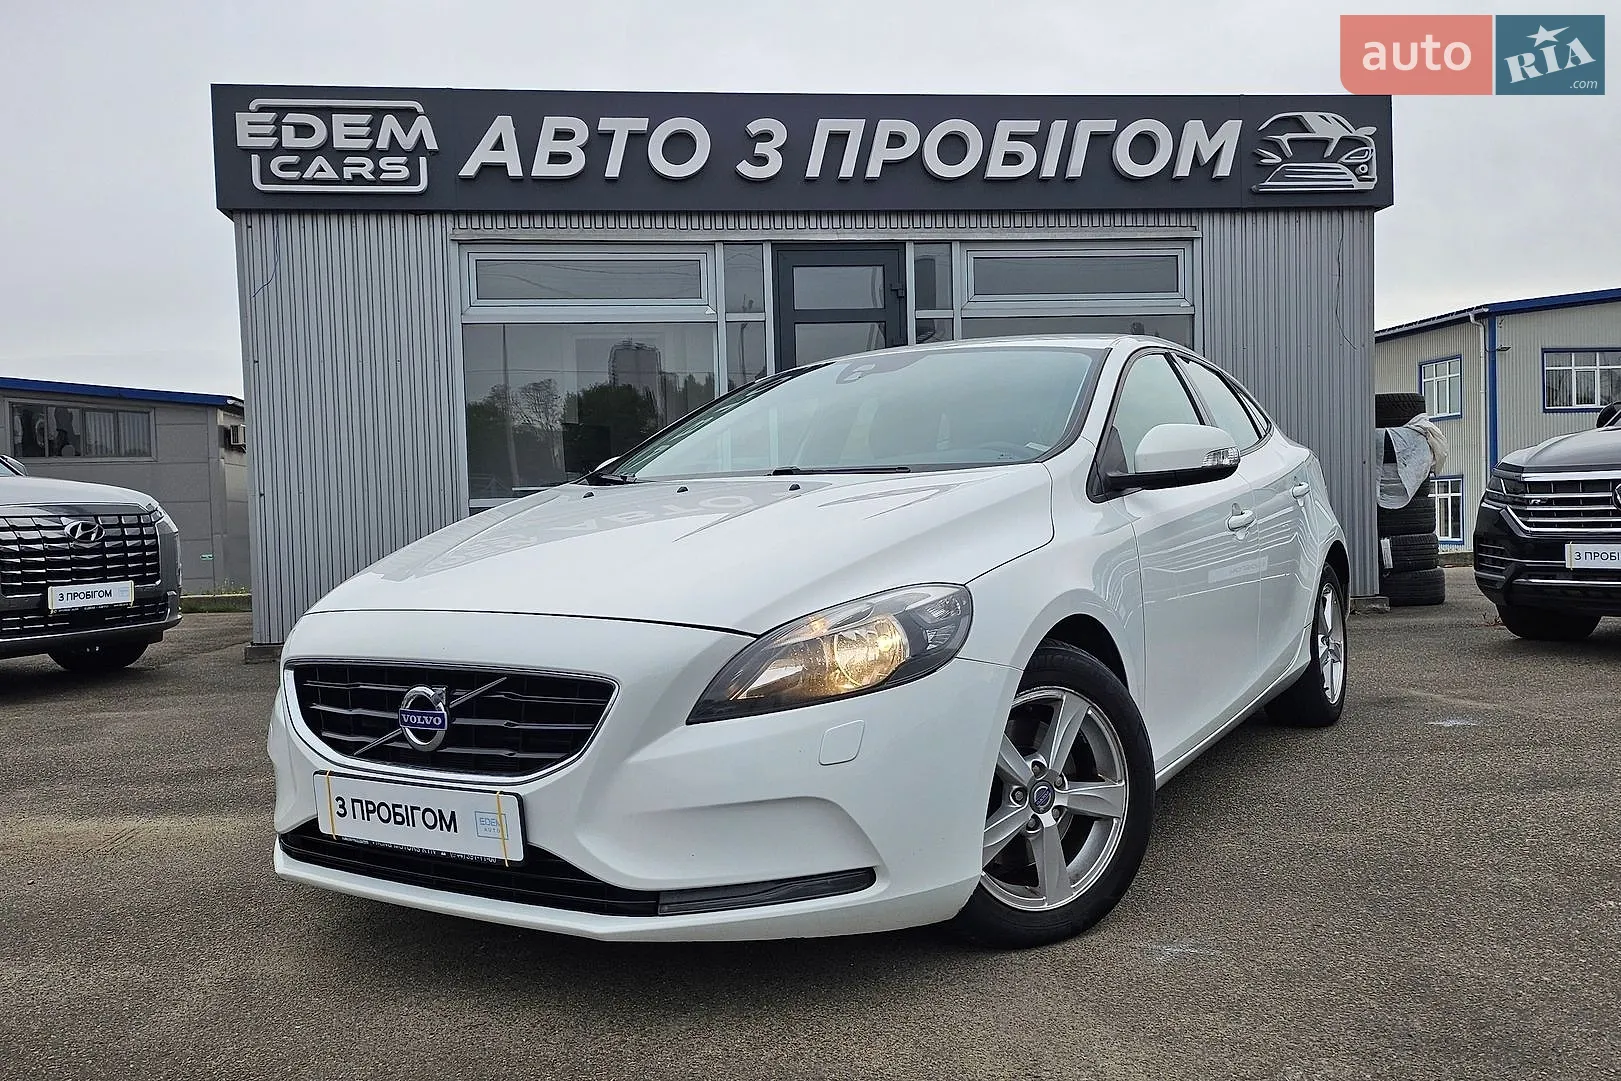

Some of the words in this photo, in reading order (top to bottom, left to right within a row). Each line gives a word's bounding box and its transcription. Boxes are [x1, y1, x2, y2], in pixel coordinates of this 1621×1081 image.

[235, 111, 439, 151] EDEM
[458, 115, 712, 181] АВТО
[804, 118, 1244, 181] ПРОБІГОМ
[269, 155, 411, 181] CARS
[66, 589, 112, 601] ПРОБІГОМ
[401, 713, 442, 726] VOLVO
[350, 798, 458, 833] ПРОБІГОМ
